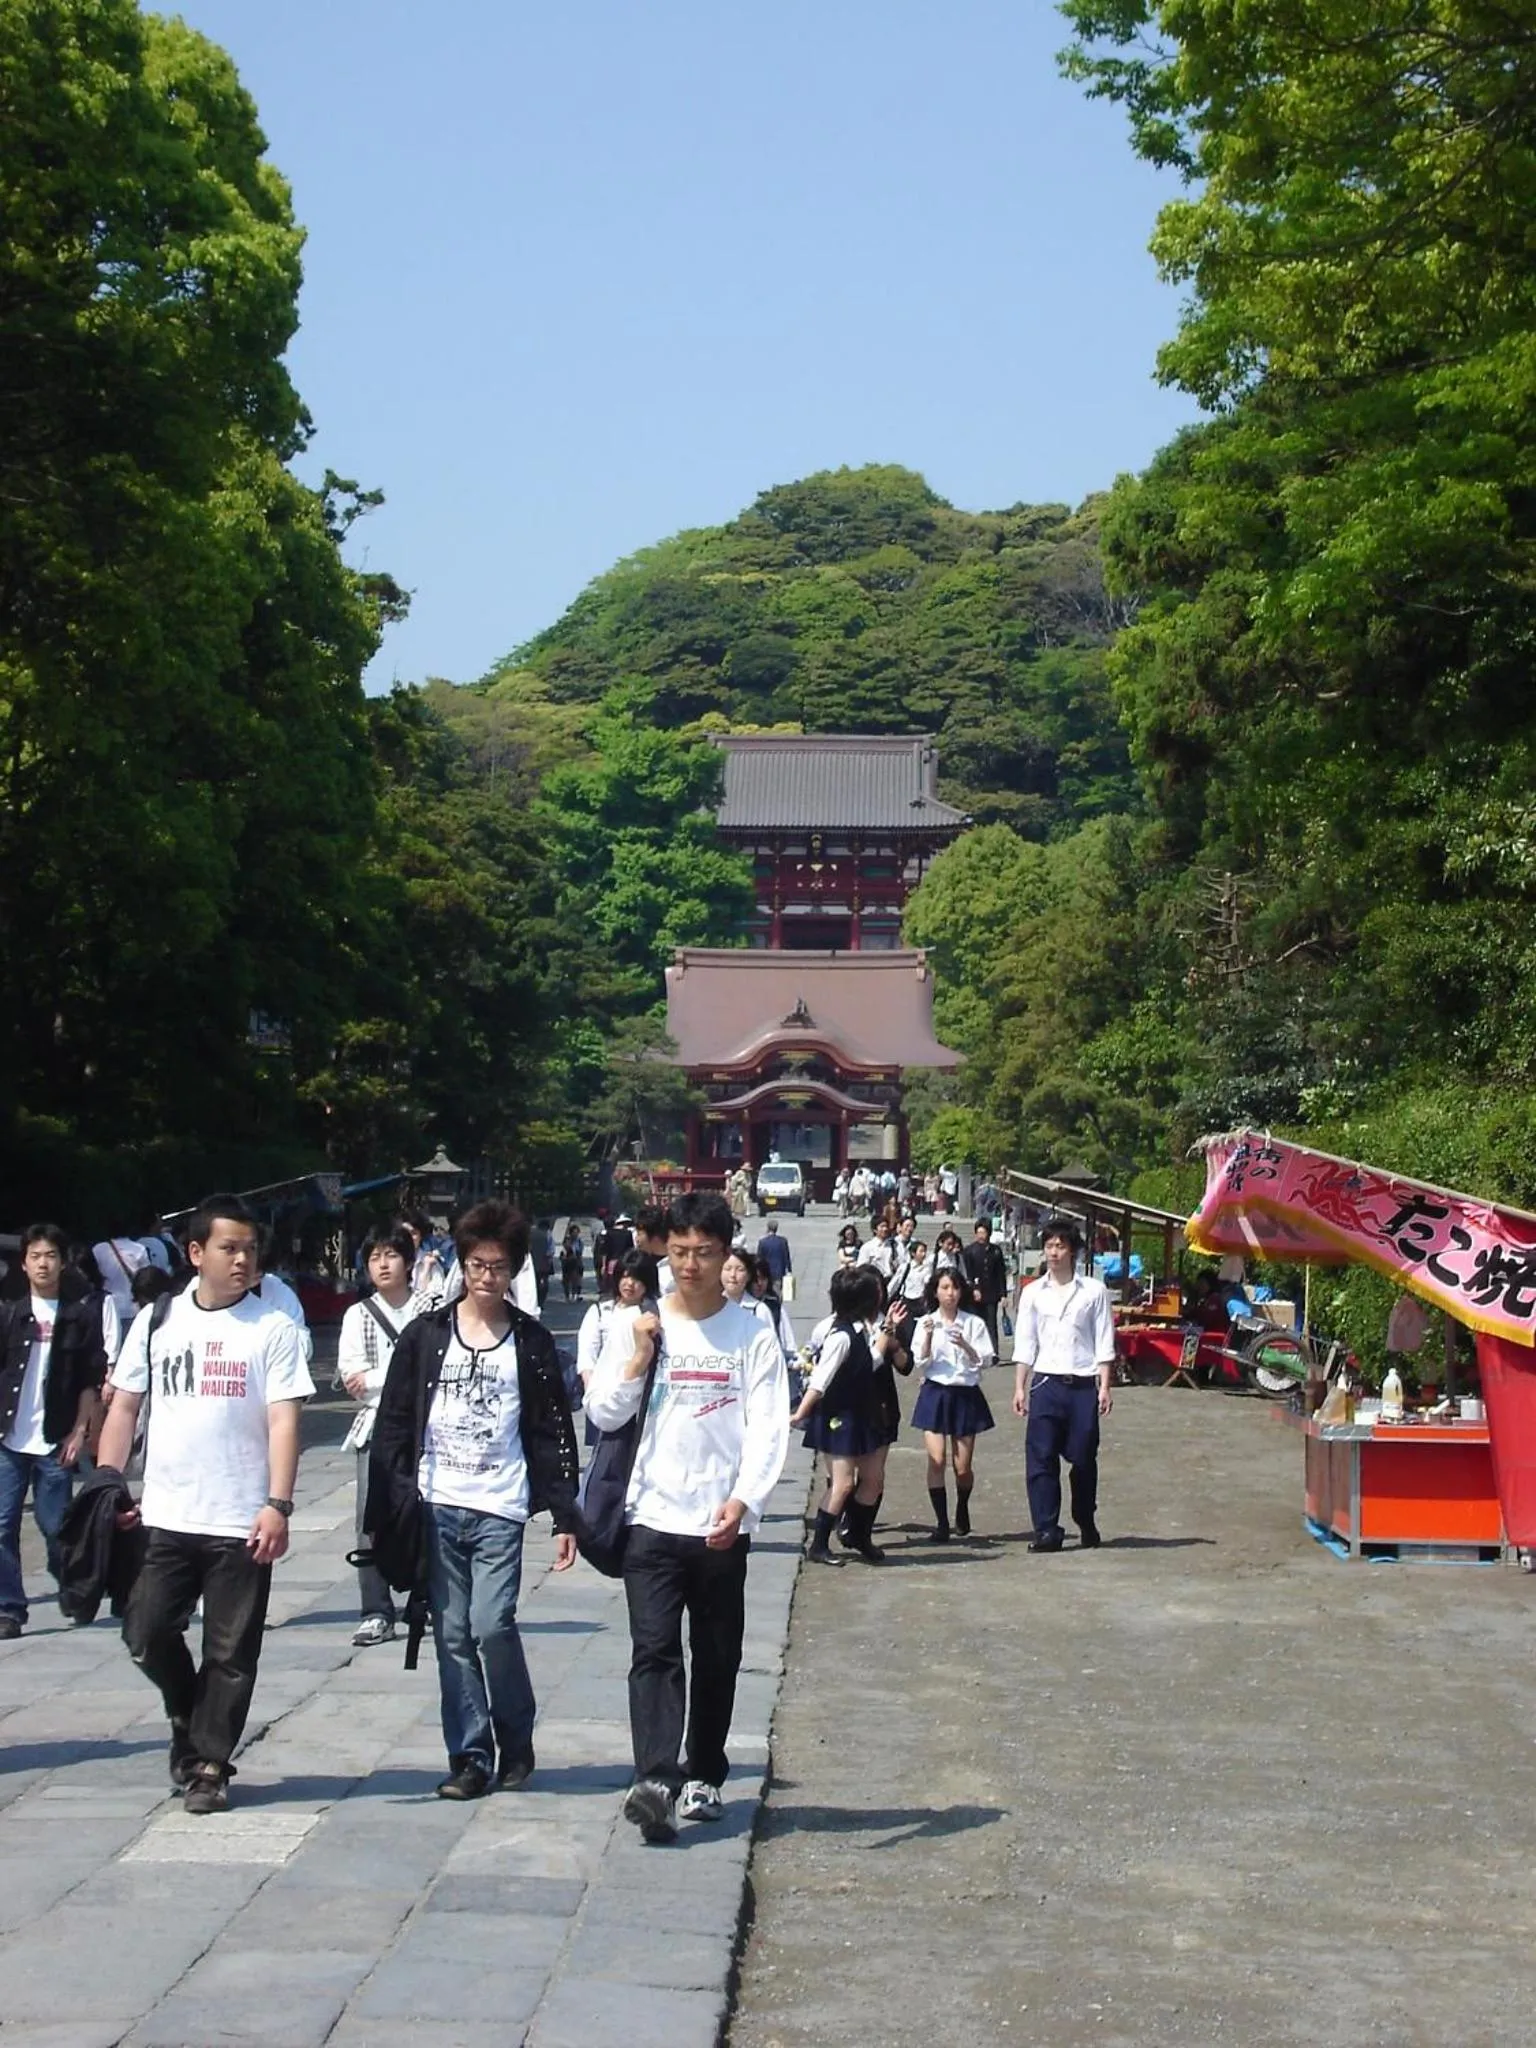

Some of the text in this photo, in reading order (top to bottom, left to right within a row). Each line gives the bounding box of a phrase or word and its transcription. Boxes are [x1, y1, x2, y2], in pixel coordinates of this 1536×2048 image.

[1379, 1194, 1536, 1318] たこ焼
[205, 1341, 224, 1357] THE
[203, 1361, 247, 1378] WAILING
[200, 1379, 247, 1398] WAILERS
